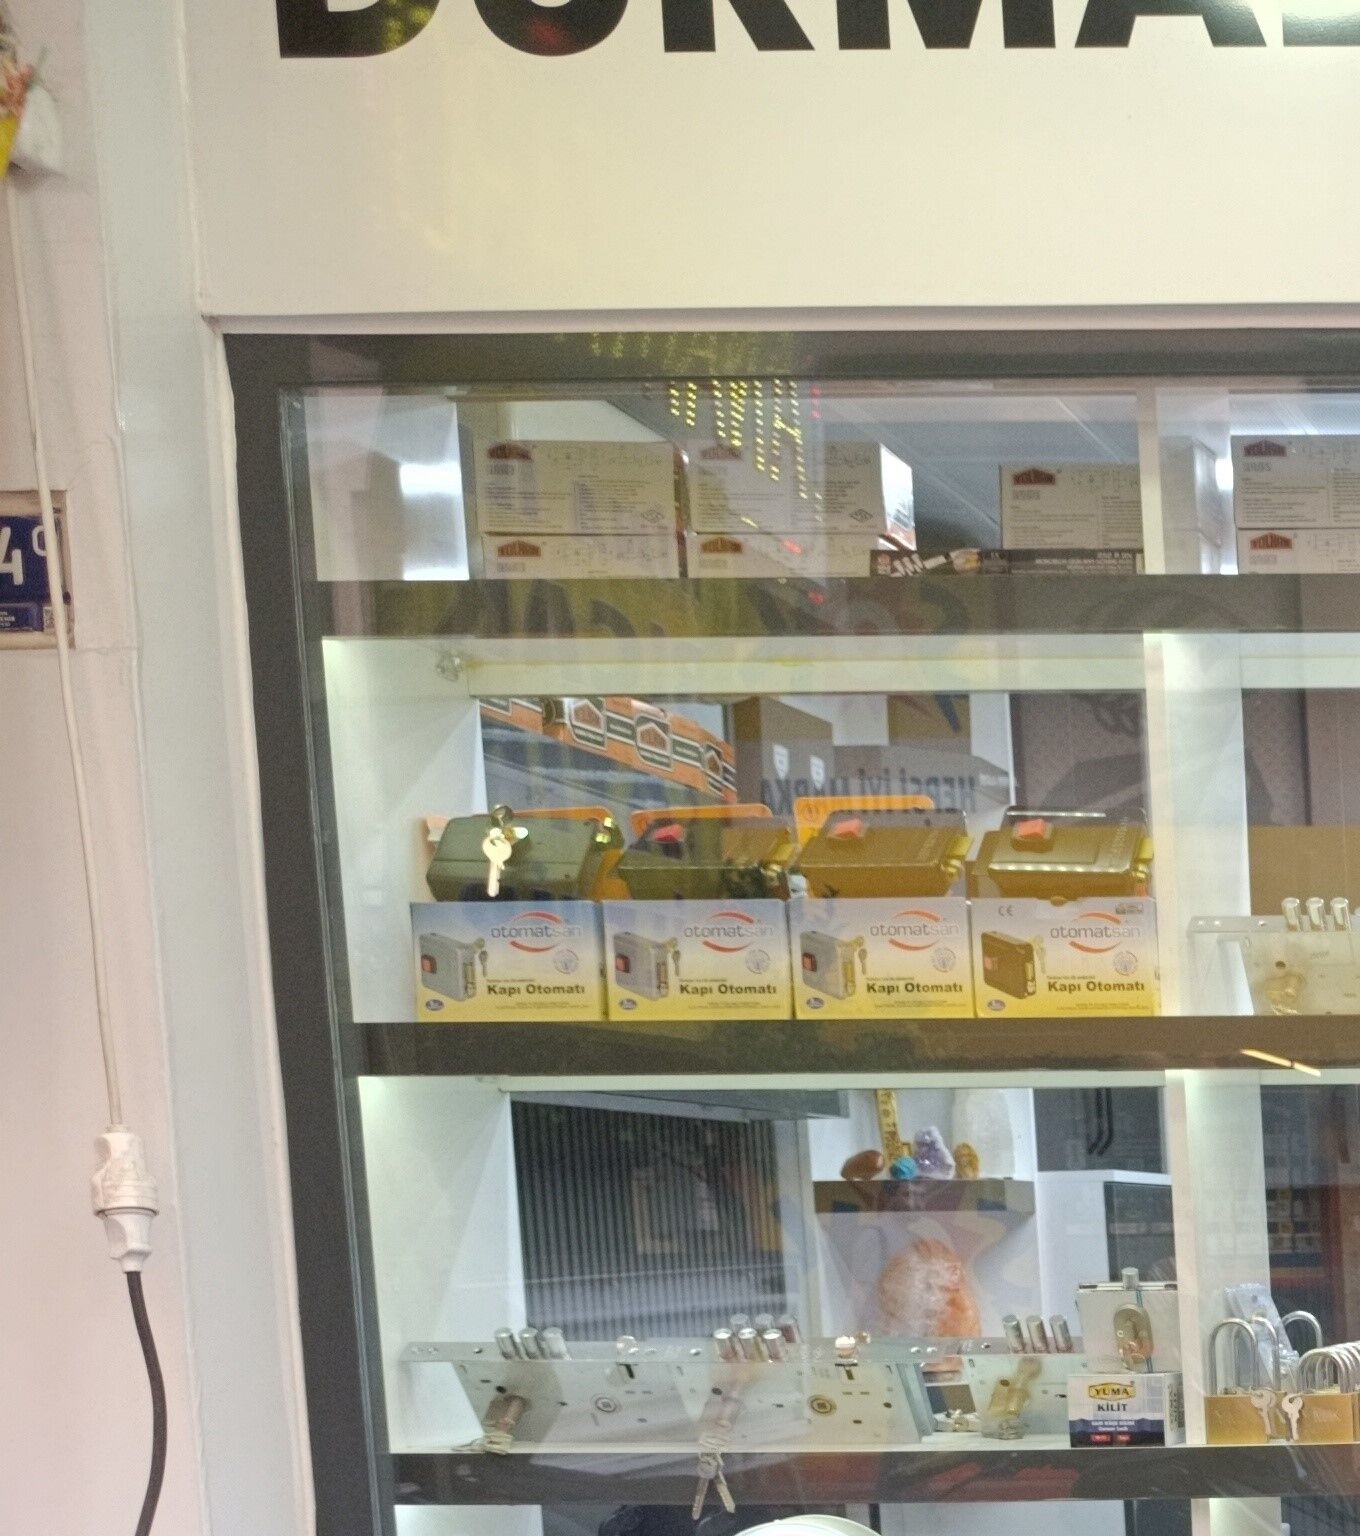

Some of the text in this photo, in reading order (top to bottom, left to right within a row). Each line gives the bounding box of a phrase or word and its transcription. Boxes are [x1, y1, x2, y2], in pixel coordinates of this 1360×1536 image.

[490, 925, 582, 938] otomatsan
[683, 925, 775, 938] otomatsan
[869, 922, 960, 937] otomatsan
[1049, 923, 1141, 938] otomatsan
[487, 984, 585, 997] Kapı Otomatı
[679, 984, 777, 997] Kapı Otomatı
[866, 982, 963, 995] Kapı Otomatı
[1047, 980, 1145, 993] Kapı Otomatı
[1094, 1387, 1131, 1397] YUMA
[1097, 1402, 1128, 1412] KİLİT
